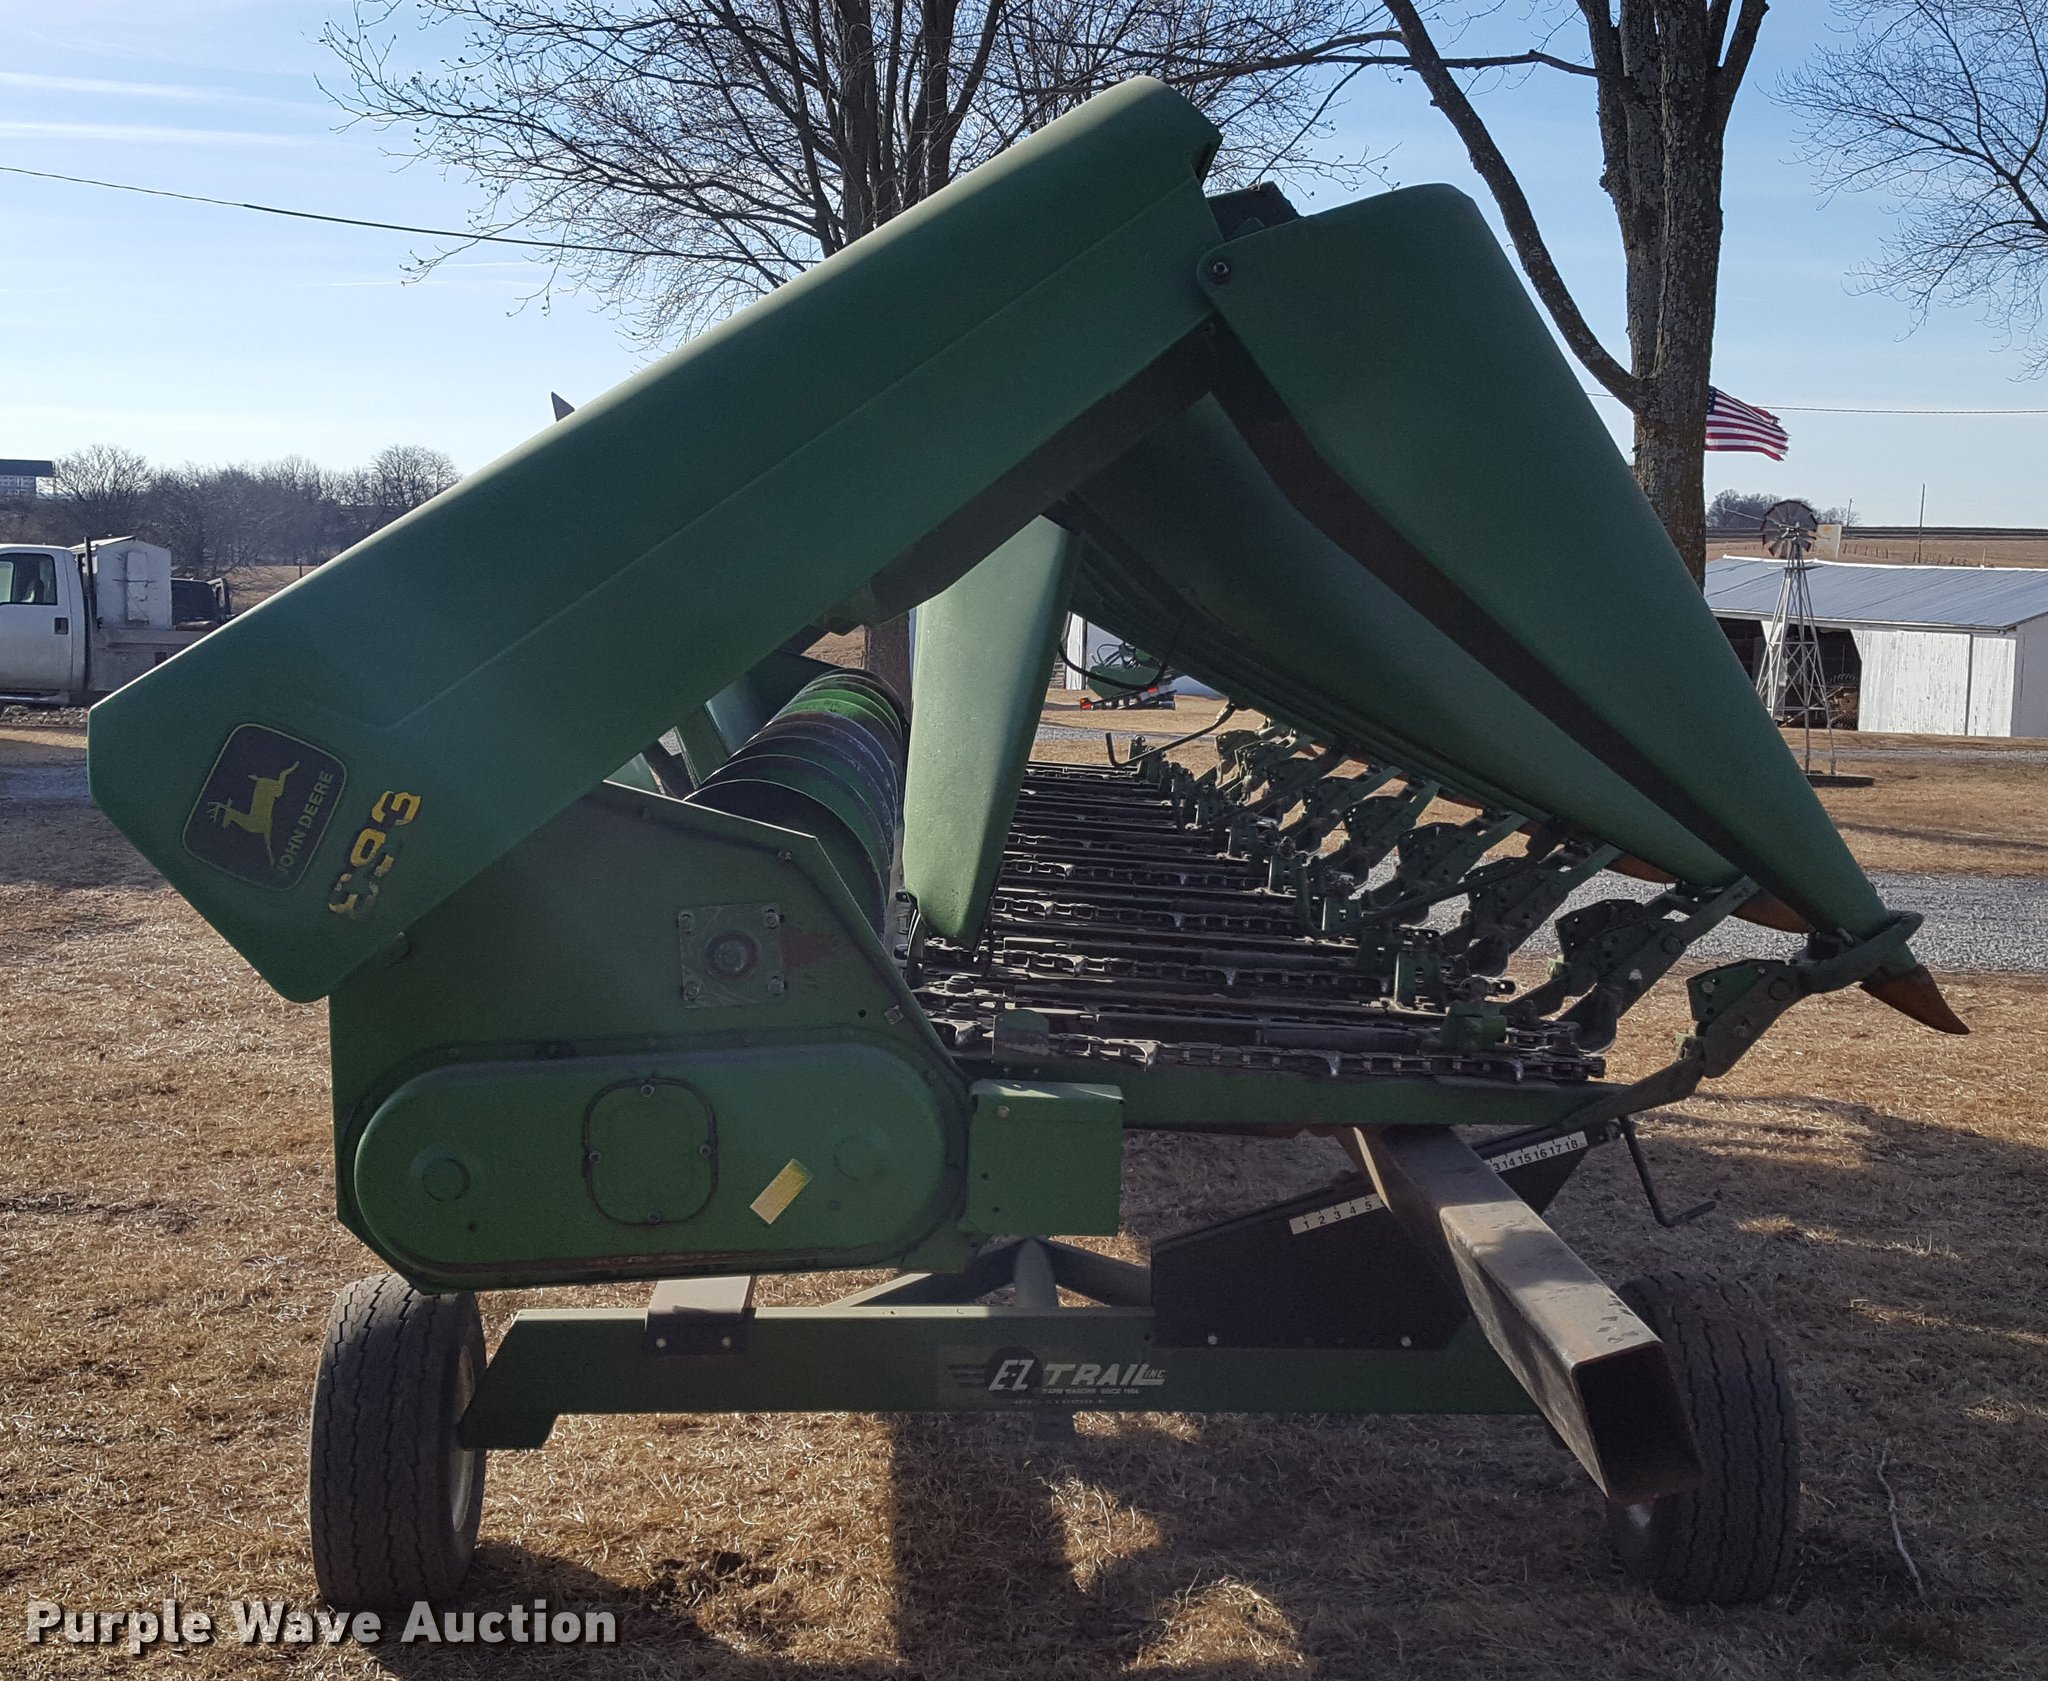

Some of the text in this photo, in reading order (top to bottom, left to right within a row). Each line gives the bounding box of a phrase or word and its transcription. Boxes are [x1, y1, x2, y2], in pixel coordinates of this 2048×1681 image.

[276, 769, 335, 876] JOHN DEERE
[1503, 1157, 1516, 1169] 14
[1518, 1152, 1532, 1164] 15
[1534, 1148, 1548, 1159] 16
[1550, 1144, 1562, 1155] 17
[1565, 1139, 1579, 1150] 18
[1303, 1201, 1373, 1229] 1 2 3 4 5
[1044, 1363, 1166, 1386] TRAIL
